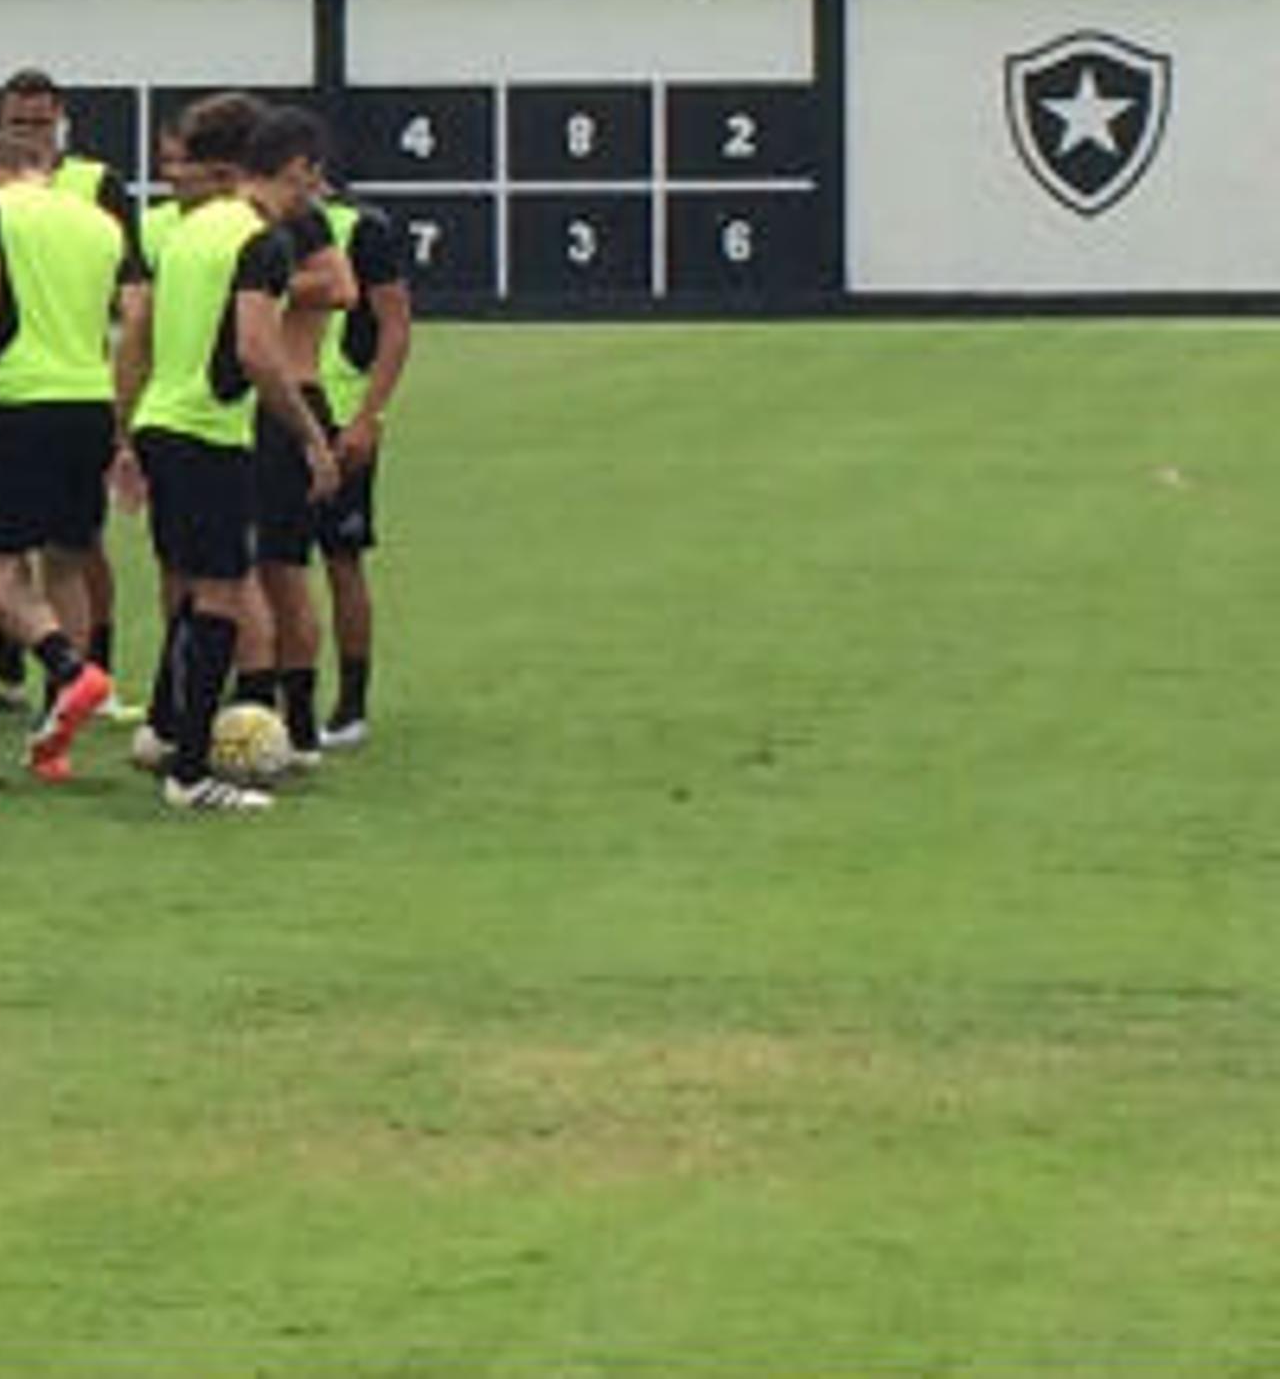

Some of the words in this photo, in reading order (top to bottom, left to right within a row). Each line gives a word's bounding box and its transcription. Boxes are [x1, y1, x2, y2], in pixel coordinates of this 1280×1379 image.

[400, 115, 436, 158] 4
[566, 114, 595, 157] 8
[721, 114, 757, 158] 2
[407, 221, 439, 263] 7
[566, 220, 596, 263] 3
[721, 220, 752, 262] 6
